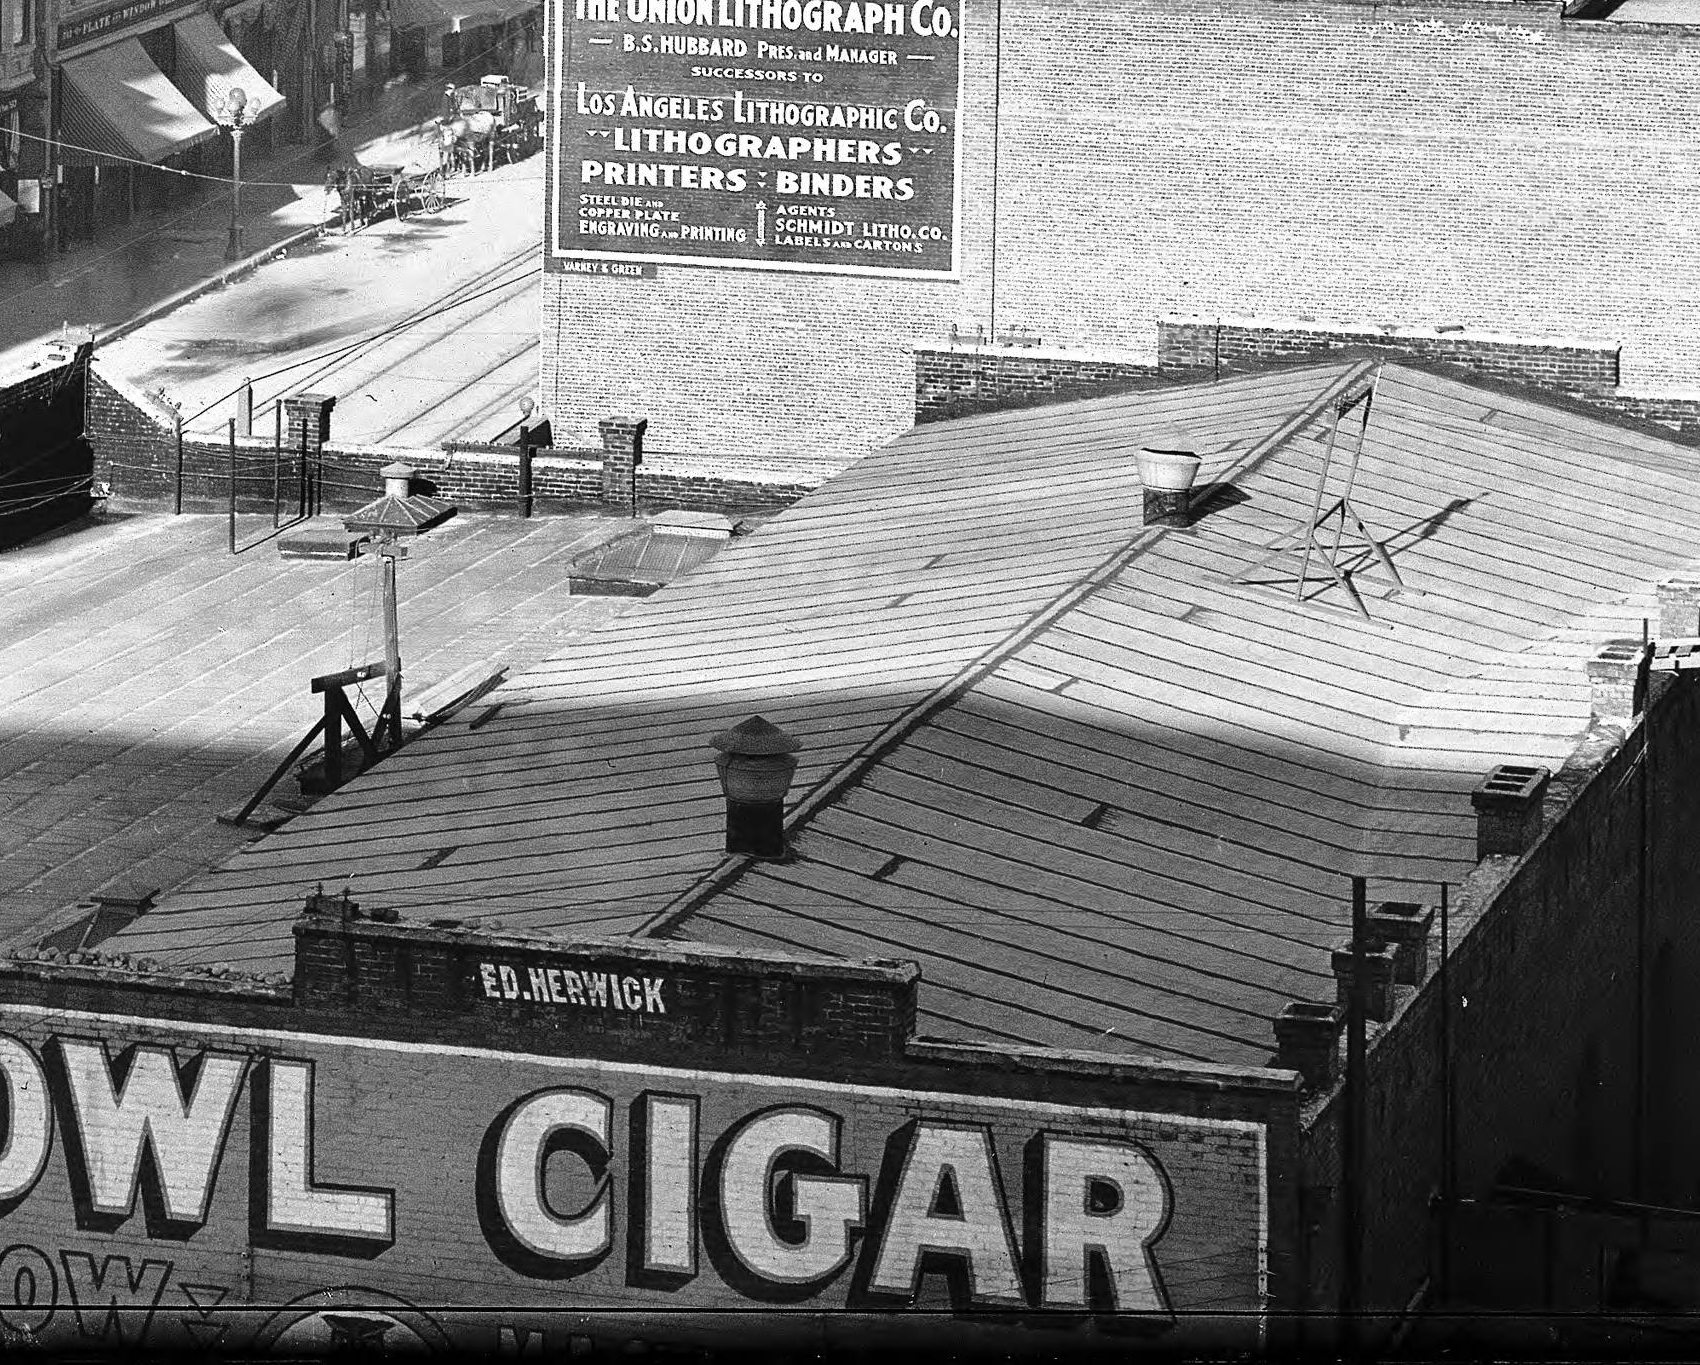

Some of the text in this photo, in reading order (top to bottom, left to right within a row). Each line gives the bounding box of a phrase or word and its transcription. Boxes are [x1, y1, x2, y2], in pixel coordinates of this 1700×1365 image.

[825, 45, 898, 65] MANAGER
[691, 66, 824, 83] SUCCESSORS TO
[576, 81, 946, 134] LOS ANGELES LITHOGRAPHIC CO.
[613, 127, 901, 165] LITHOGRAPHERS
[581, 161, 915, 200] PRINTERS BINDERS
[579, 194, 618, 207] STEEL
[621, 196, 642, 208] DIE
[777, 205, 835, 217] AGENTS
[579, 208, 680, 222] COPPER PLATE
[579, 221, 746, 243] ENGRAVING AND PRINTING
[775, 218, 854, 238] SCHMIDT
[775, 234, 924, 254] LABELS AND CARTONS
[563, 261, 598, 273] VARNEY
[612, 264, 643, 275] GREEN
[475, 1086, 1176, 1323] CIGAR
